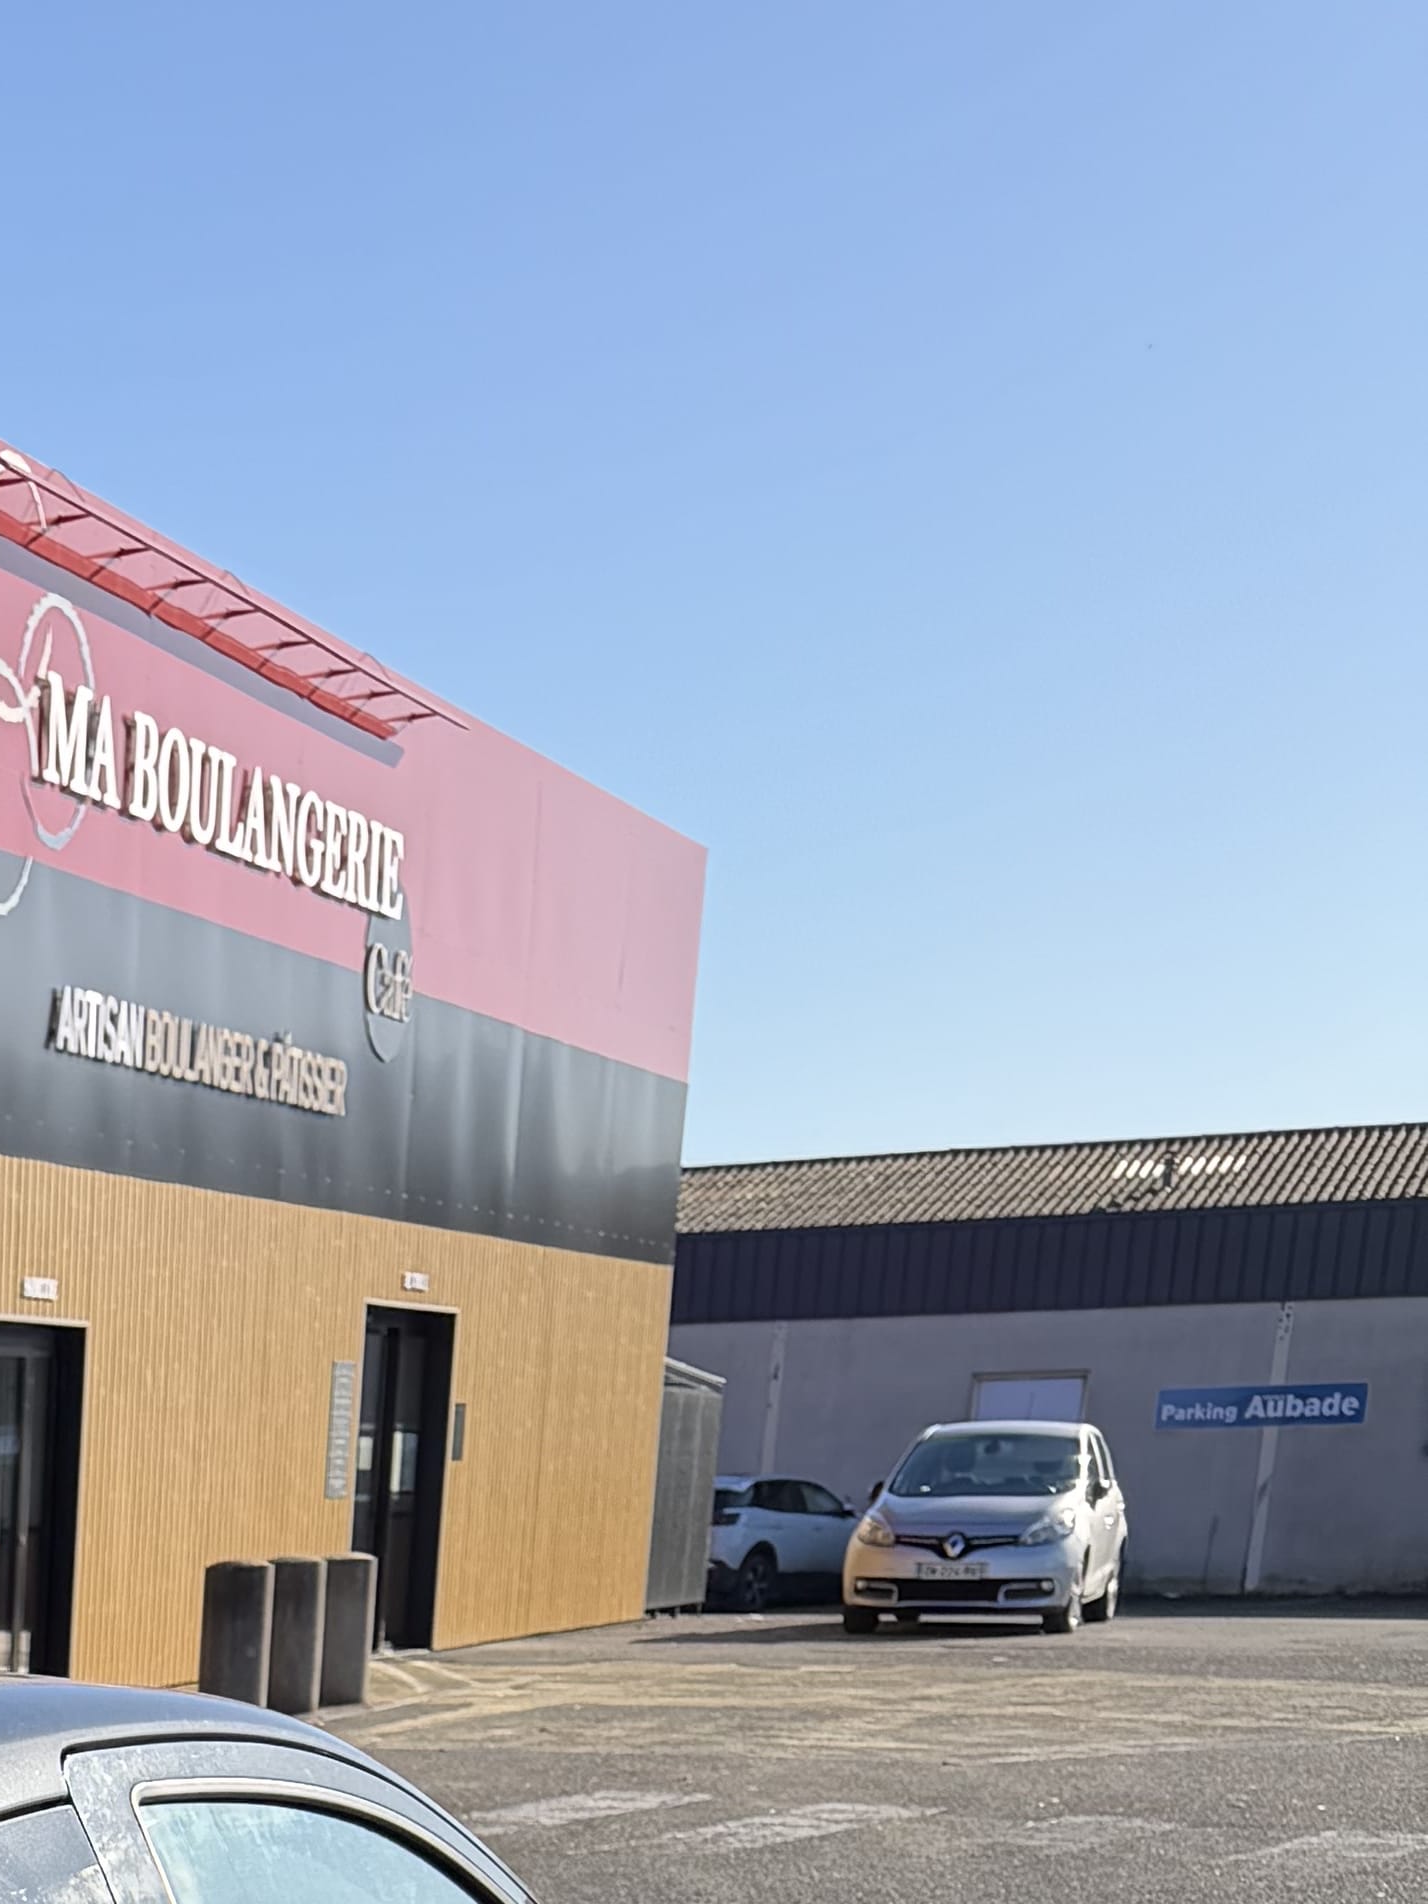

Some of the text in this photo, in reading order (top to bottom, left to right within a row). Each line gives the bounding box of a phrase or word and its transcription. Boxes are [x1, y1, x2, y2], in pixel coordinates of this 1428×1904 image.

[42, 669, 405, 921] MA BOULANGERIE
[55, 984, 145, 1069] ARTISAN
[144, 1008, 255, 1095] BOULANGER
[254, 1037, 270, 1100] &
[1160, 1391, 1360, 1424] Parking Aubade
